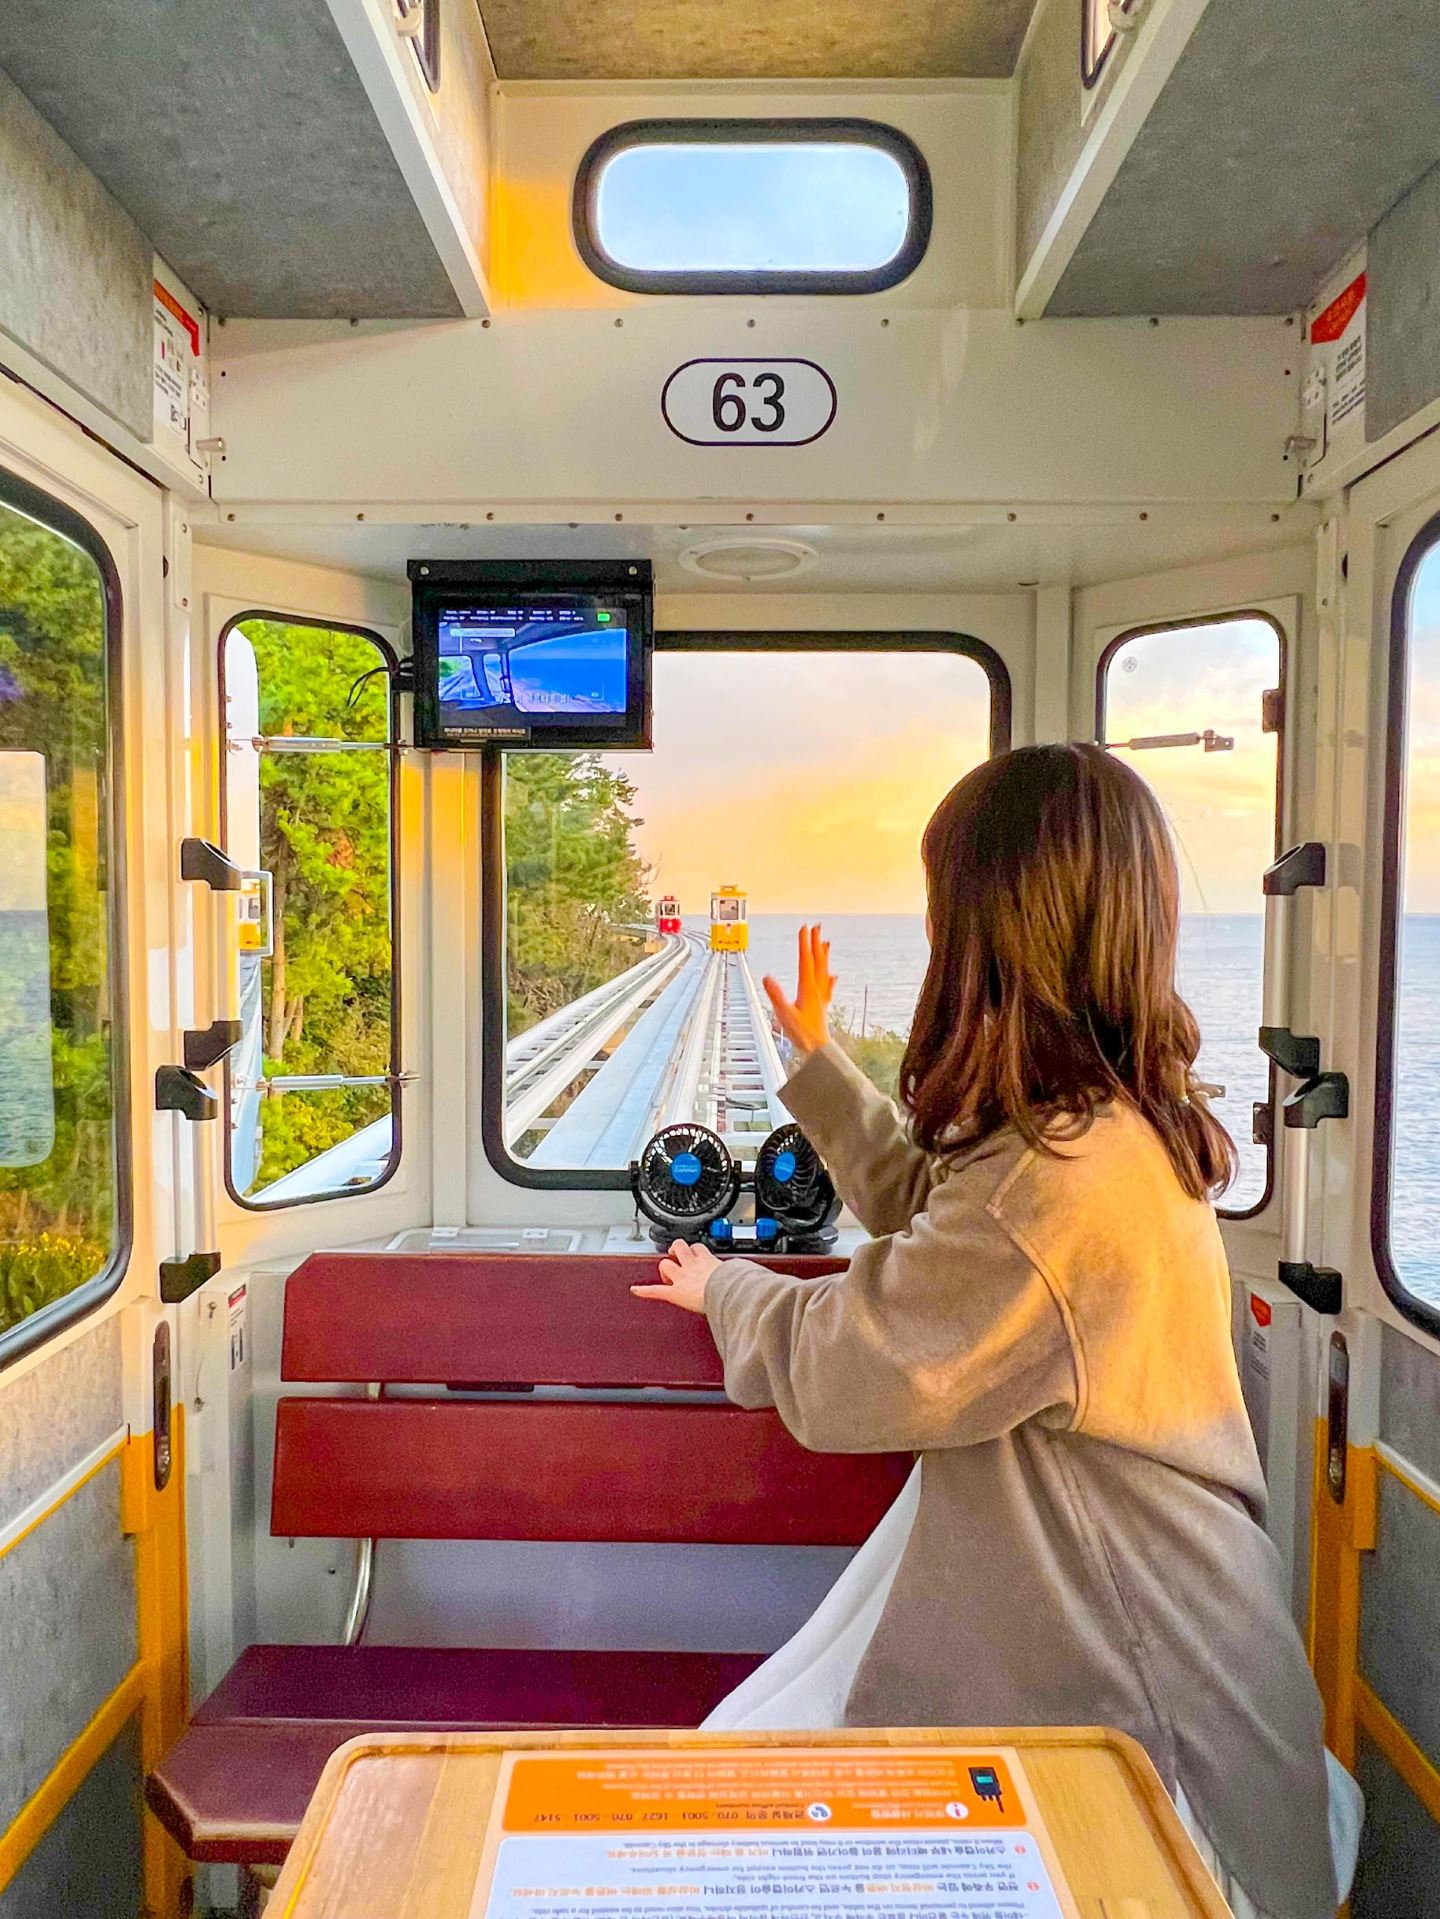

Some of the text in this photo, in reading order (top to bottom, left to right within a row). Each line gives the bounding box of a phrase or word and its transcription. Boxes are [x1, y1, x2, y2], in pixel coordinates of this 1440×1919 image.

[712, 372, 785, 432] 63
[955, 1846, 1005, 1855] 스카이캡슐
[750, 1884, 815, 1894] 스카이캡슐이
